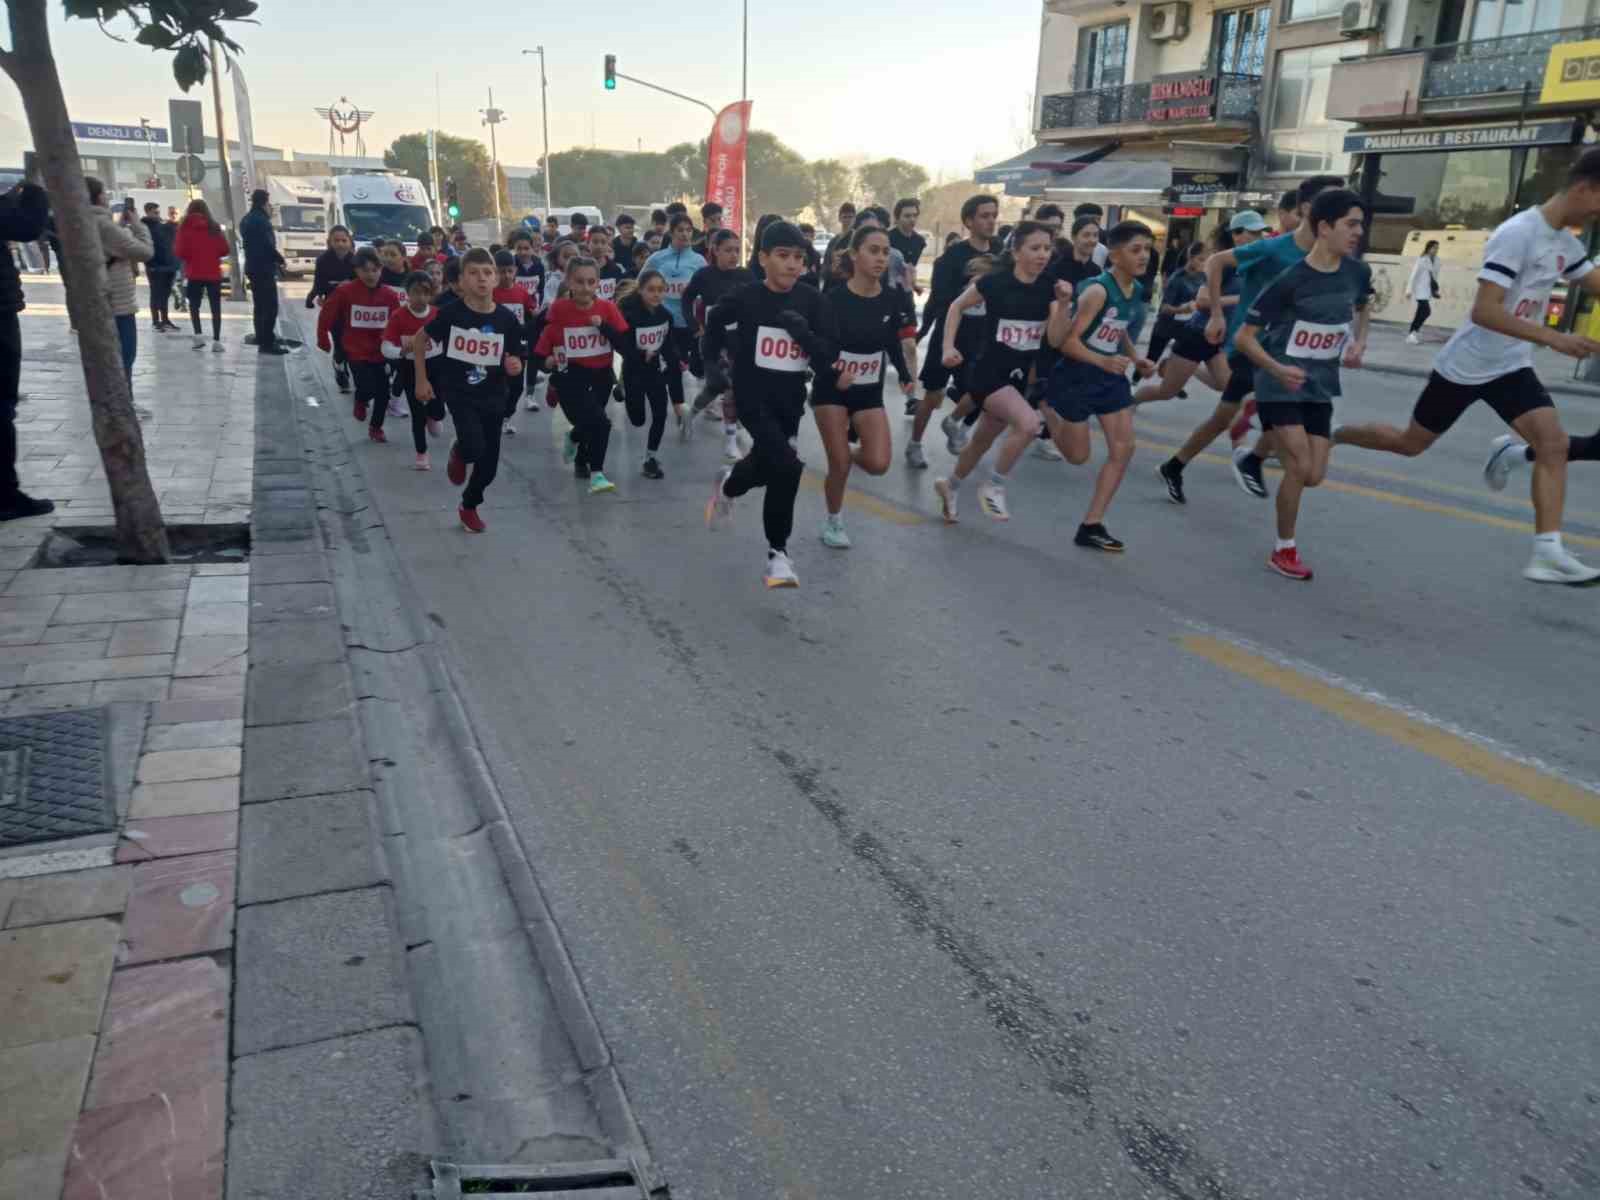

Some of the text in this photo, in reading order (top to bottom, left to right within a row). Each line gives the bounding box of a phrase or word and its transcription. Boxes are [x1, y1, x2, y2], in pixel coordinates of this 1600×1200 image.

[1364, 126, 1540, 149] PAMUKKALE RESTAURANT
[454, 335, 500, 358] 0051
